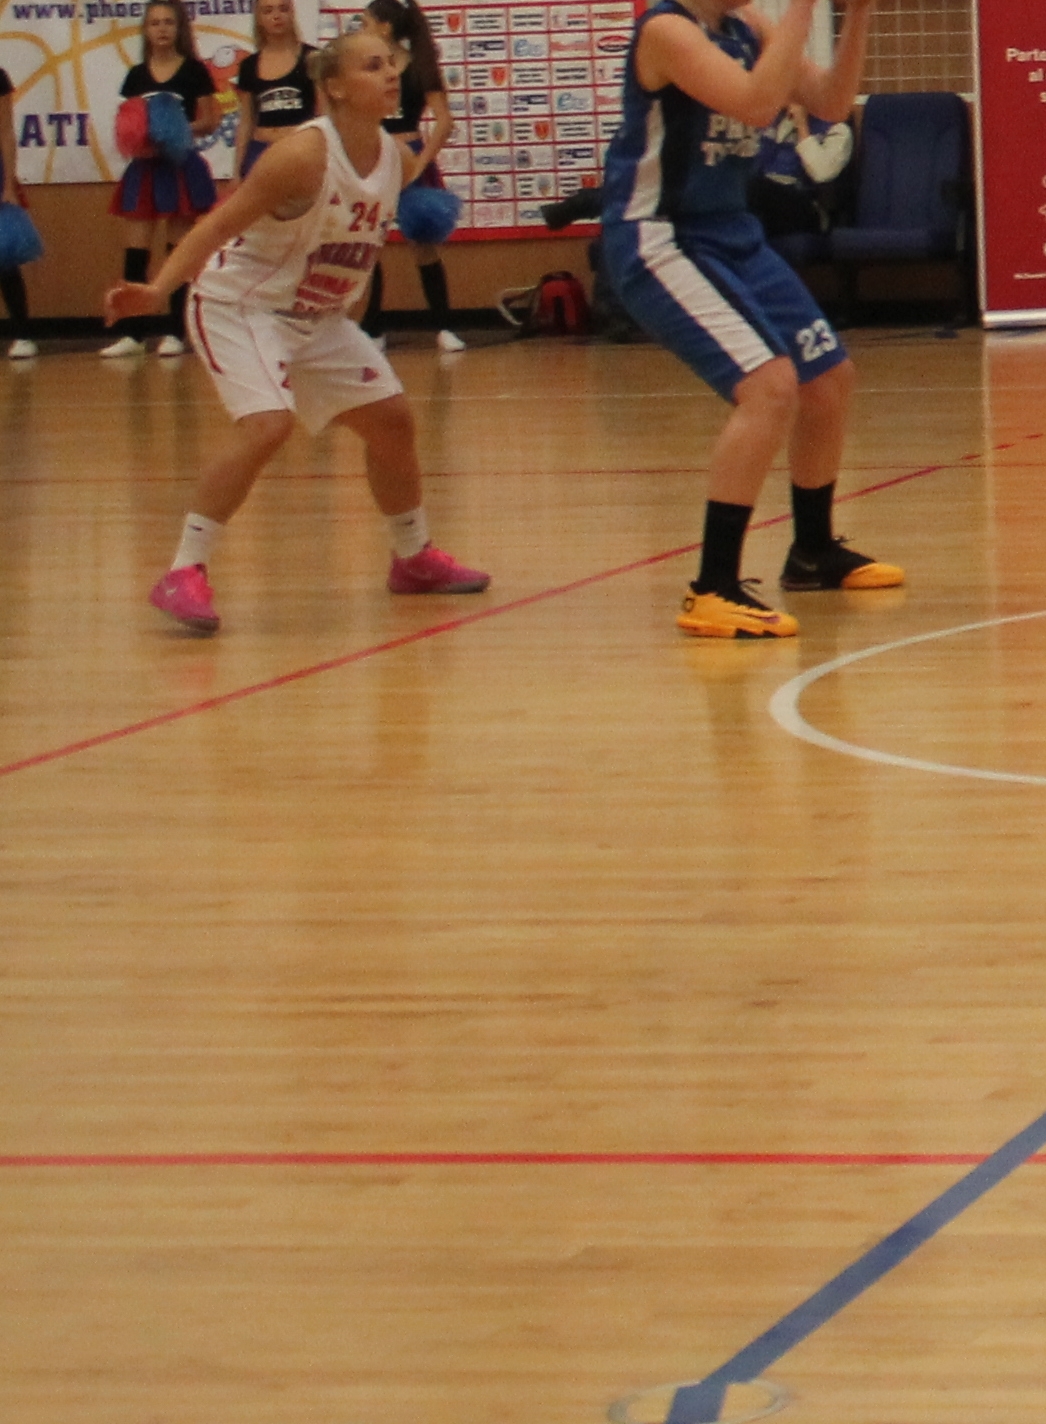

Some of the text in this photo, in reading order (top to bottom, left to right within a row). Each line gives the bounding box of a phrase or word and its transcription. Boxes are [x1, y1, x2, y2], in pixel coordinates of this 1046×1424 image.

[1029, 69, 1043, 82] al
[349, 202, 381, 232] 24
[796, 318, 838, 363] 23
